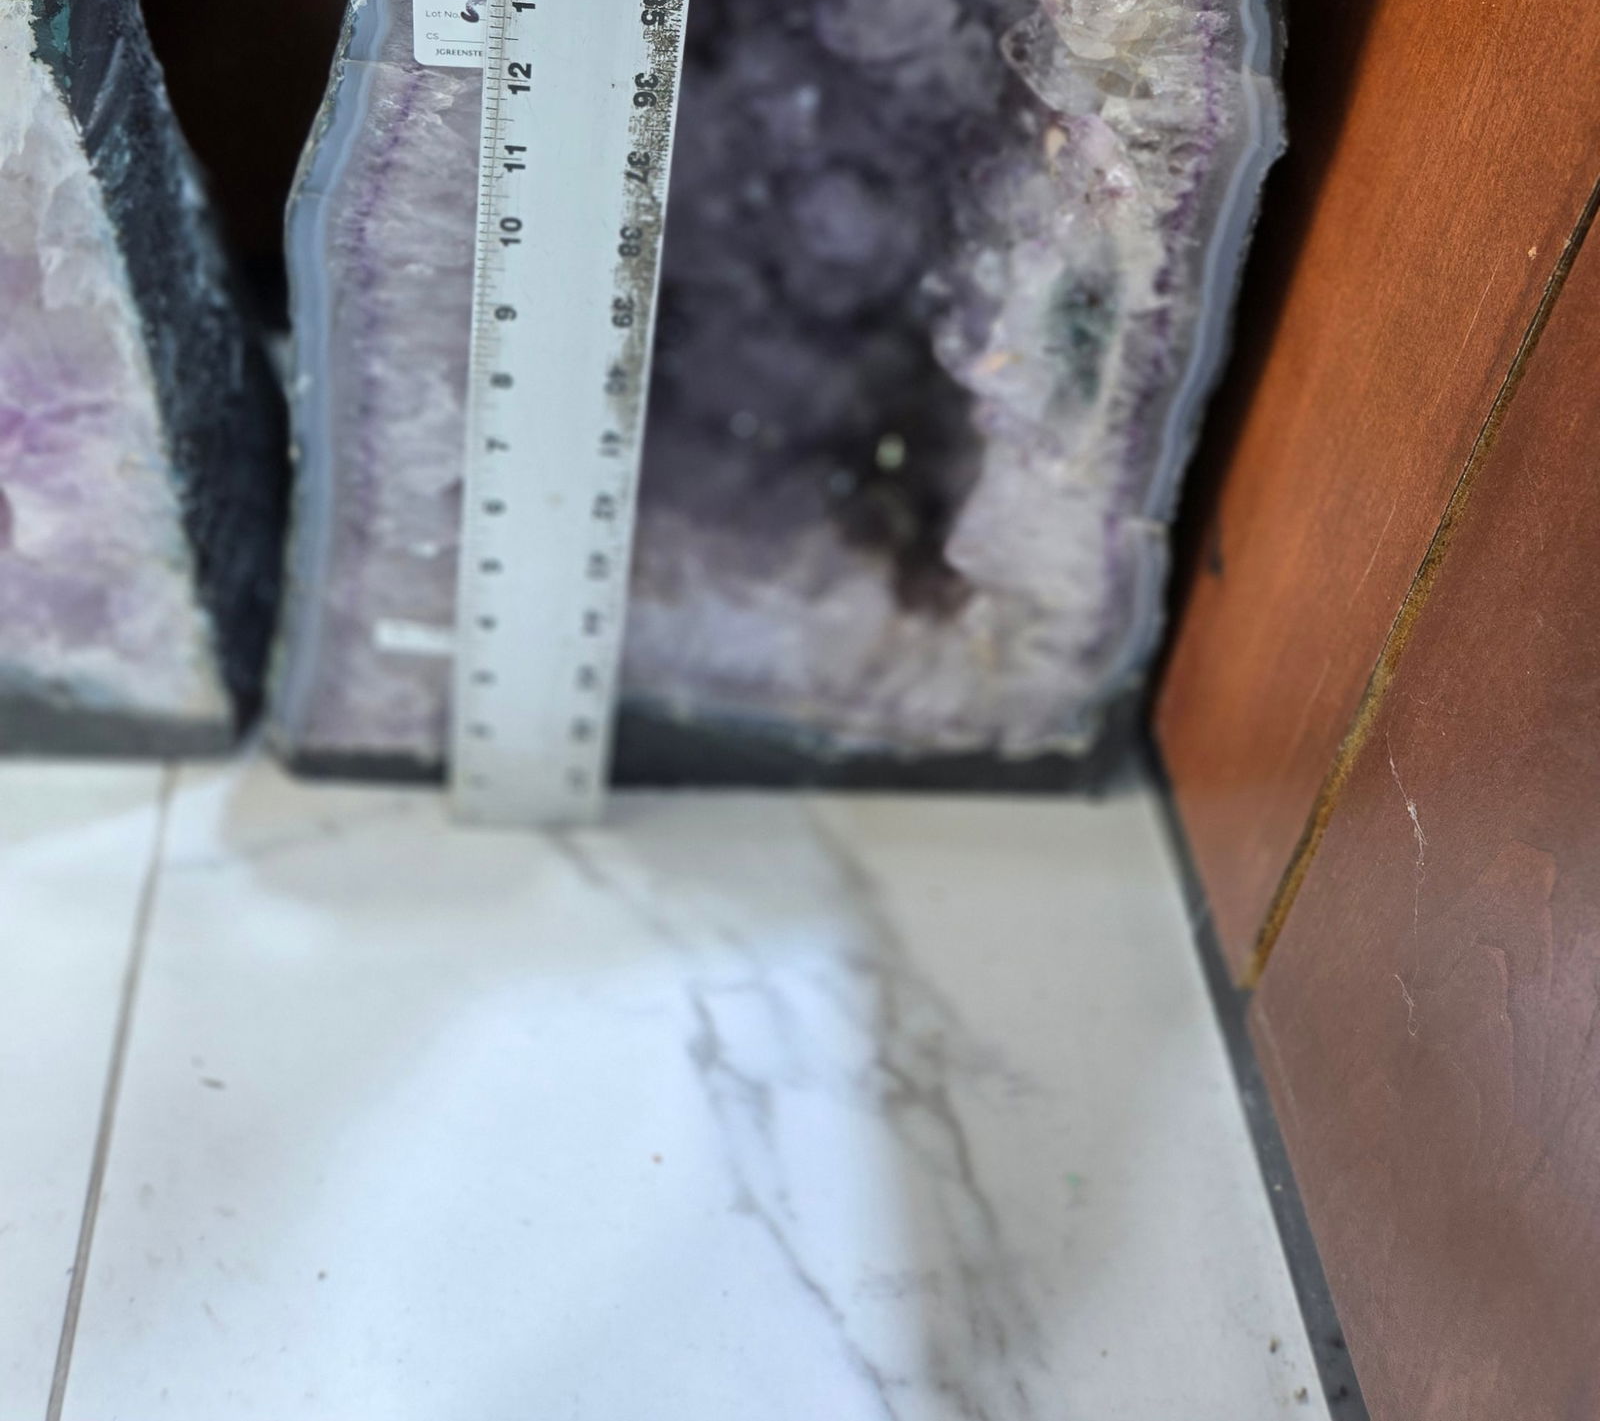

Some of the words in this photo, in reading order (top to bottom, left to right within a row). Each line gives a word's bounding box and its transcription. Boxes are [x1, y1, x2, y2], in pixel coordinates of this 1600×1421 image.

[425, 10, 441, 18] Lot
[426, 32, 440, 40] CS
[508, 62, 532, 95] 12
[633, 73, 659, 107] 36
[503, 145, 527, 173] 11
[624, 151, 650, 184] 37
[500, 217, 522, 247] 10
[618, 226, 643, 257] 38
[494, 305, 517, 322] 9
[611, 296, 635, 328] 39
